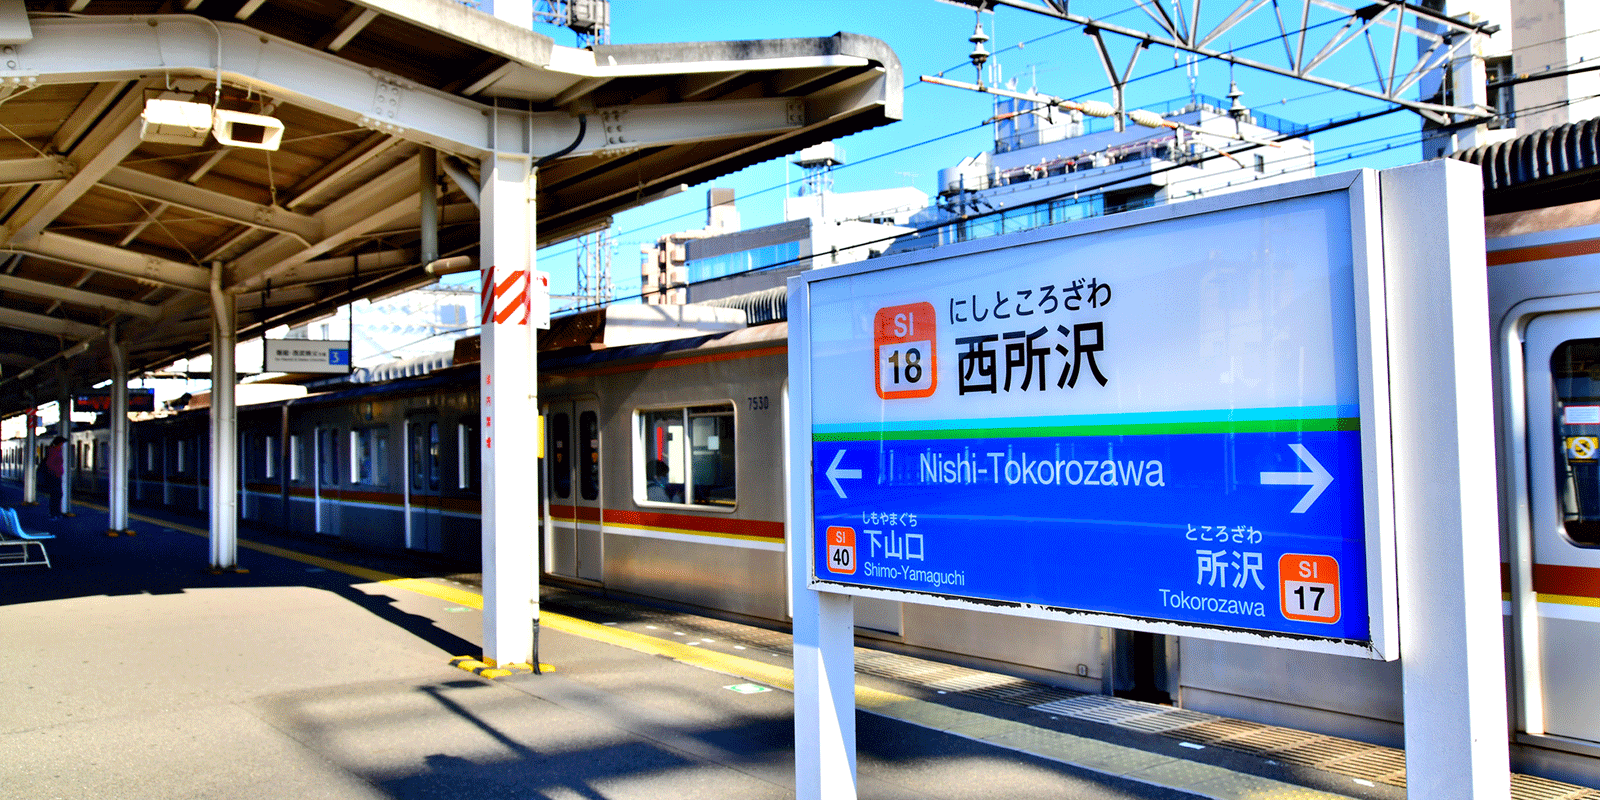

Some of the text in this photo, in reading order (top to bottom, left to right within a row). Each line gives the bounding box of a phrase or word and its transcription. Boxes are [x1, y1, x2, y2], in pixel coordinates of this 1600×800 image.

[949, 277, 1112, 325] にしところざわ
[893, 312, 914, 338] SI
[888, 347, 923, 385] 18
[954, 321, 1109, 396] 西所沢
[748, 396, 769, 410] 7530
[919, 452, 1166, 488] Nishi-Tokorozawa
[862, 511, 918, 528] しもやまぐち
[835, 530, 847, 544] SI
[863, 529, 925, 562] 下山口
[1185, 523, 1263, 545] ところざわ
[832, 548, 851, 568] 40
[1195, 549, 1266, 591] 所沢
[1298, 560, 1318, 579] SI
[863, 562, 966, 588] Shimo-Yamaguchi
[1158, 588, 1266, 617] Tokorozawa
[1293, 585, 1325, 612] 17
